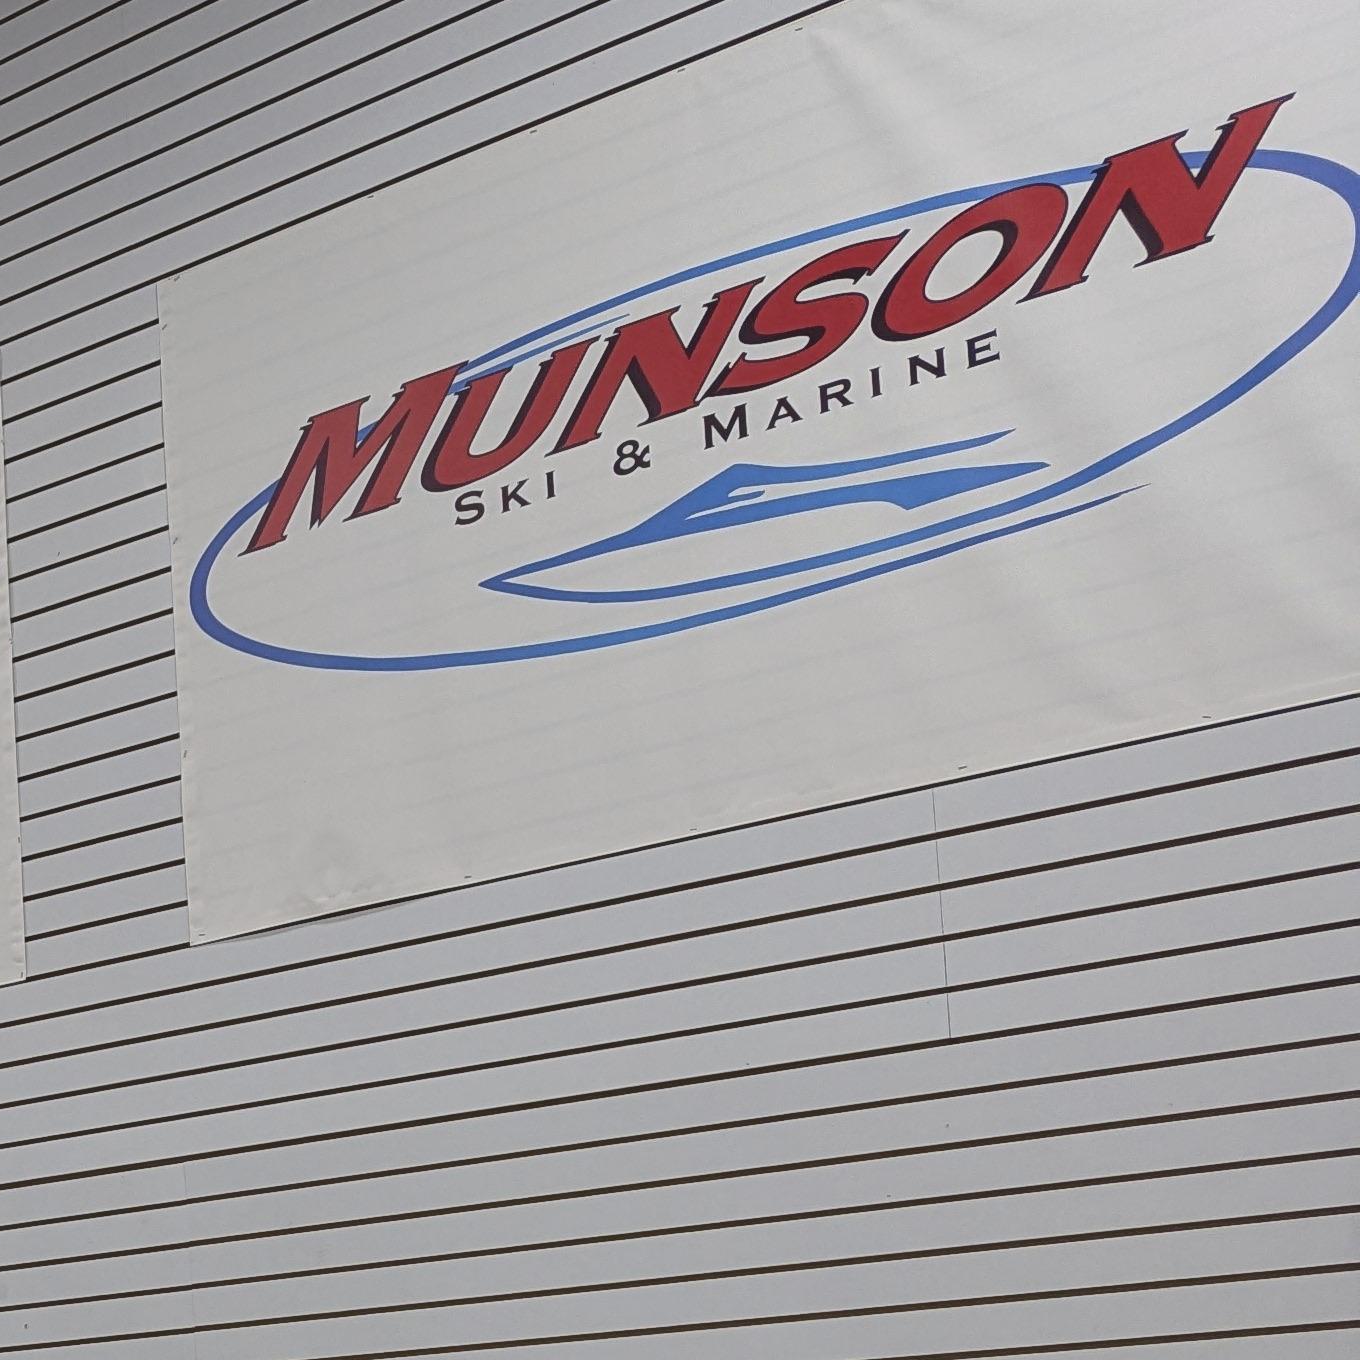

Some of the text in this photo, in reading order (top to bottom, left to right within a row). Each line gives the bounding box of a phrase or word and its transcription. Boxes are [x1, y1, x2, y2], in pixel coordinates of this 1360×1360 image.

[238, 93, 1295, 557] MUNSON
[454, 328, 1001, 527] SKI & MARINE
